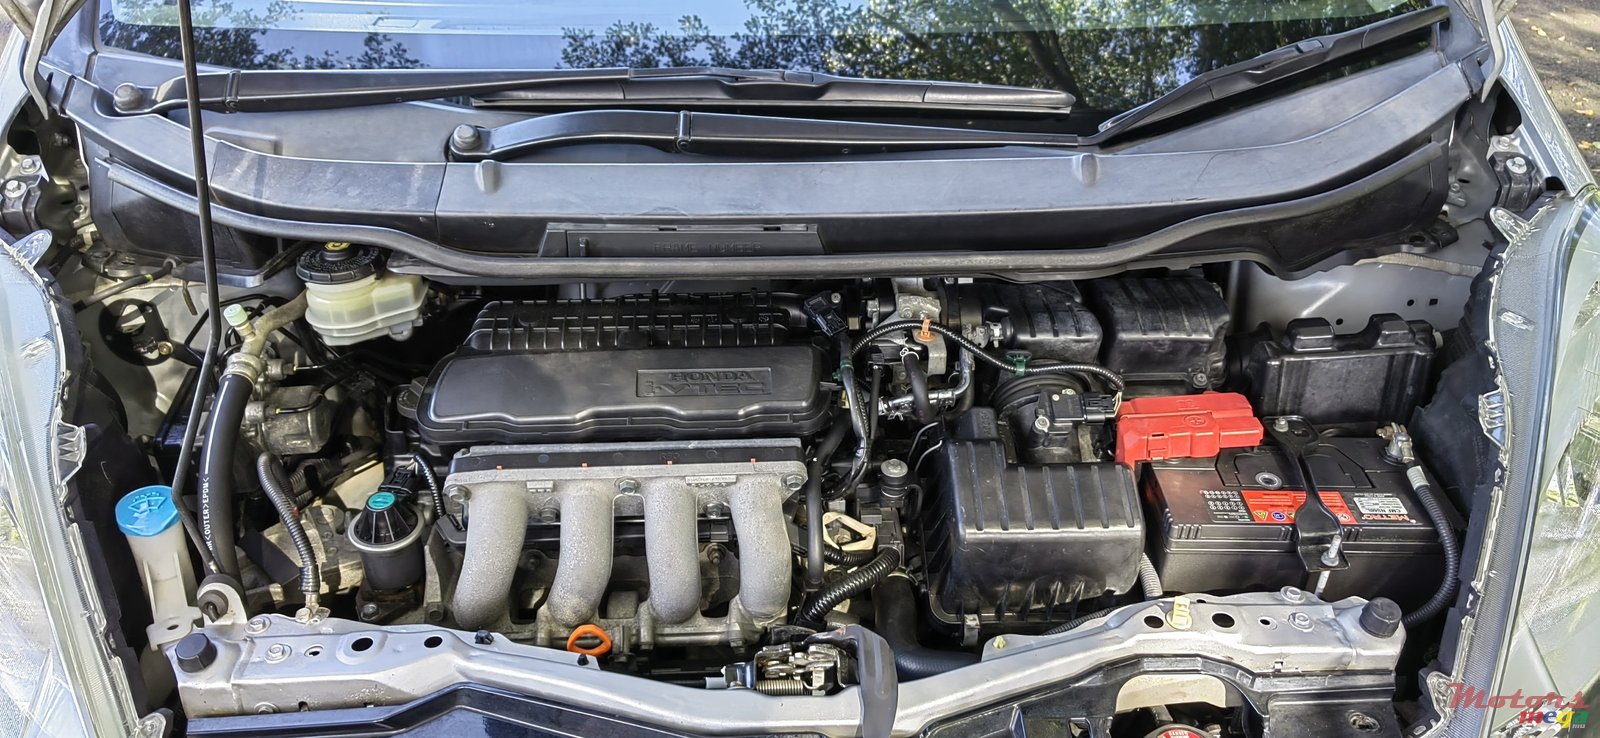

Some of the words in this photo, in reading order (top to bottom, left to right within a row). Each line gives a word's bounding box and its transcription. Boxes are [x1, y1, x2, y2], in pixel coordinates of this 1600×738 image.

[654, 241, 698, 253] FRAME
[668, 370, 760, 383] HONDA
[1362, 513, 1411, 522] METRO
